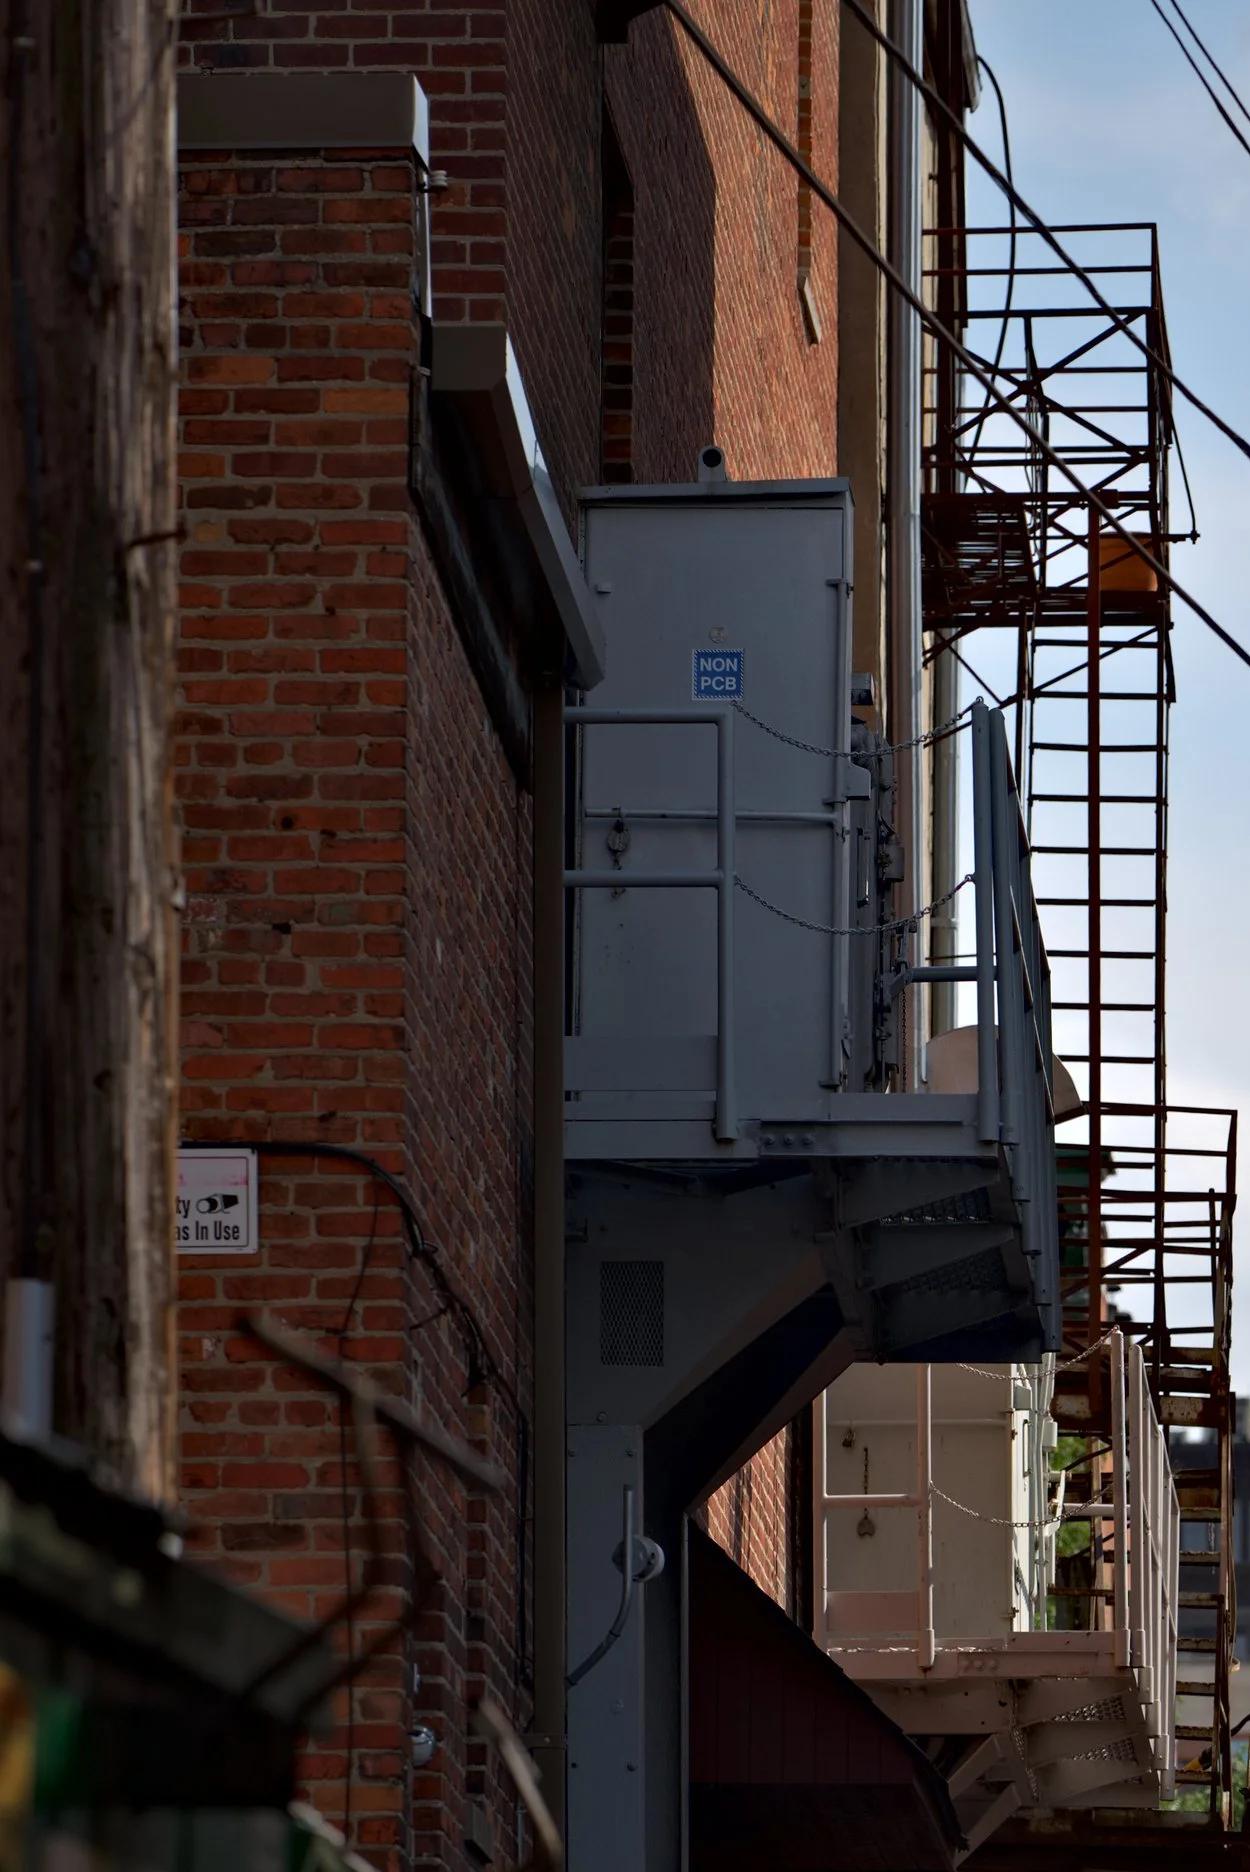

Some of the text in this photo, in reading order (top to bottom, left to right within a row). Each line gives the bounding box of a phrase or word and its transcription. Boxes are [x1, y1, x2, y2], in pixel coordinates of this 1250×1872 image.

[699, 657, 738, 672] NON
[700, 676, 737, 691] PCB
[195, 1220, 209, 1241] In
[213, 1220, 240, 1241] Use
